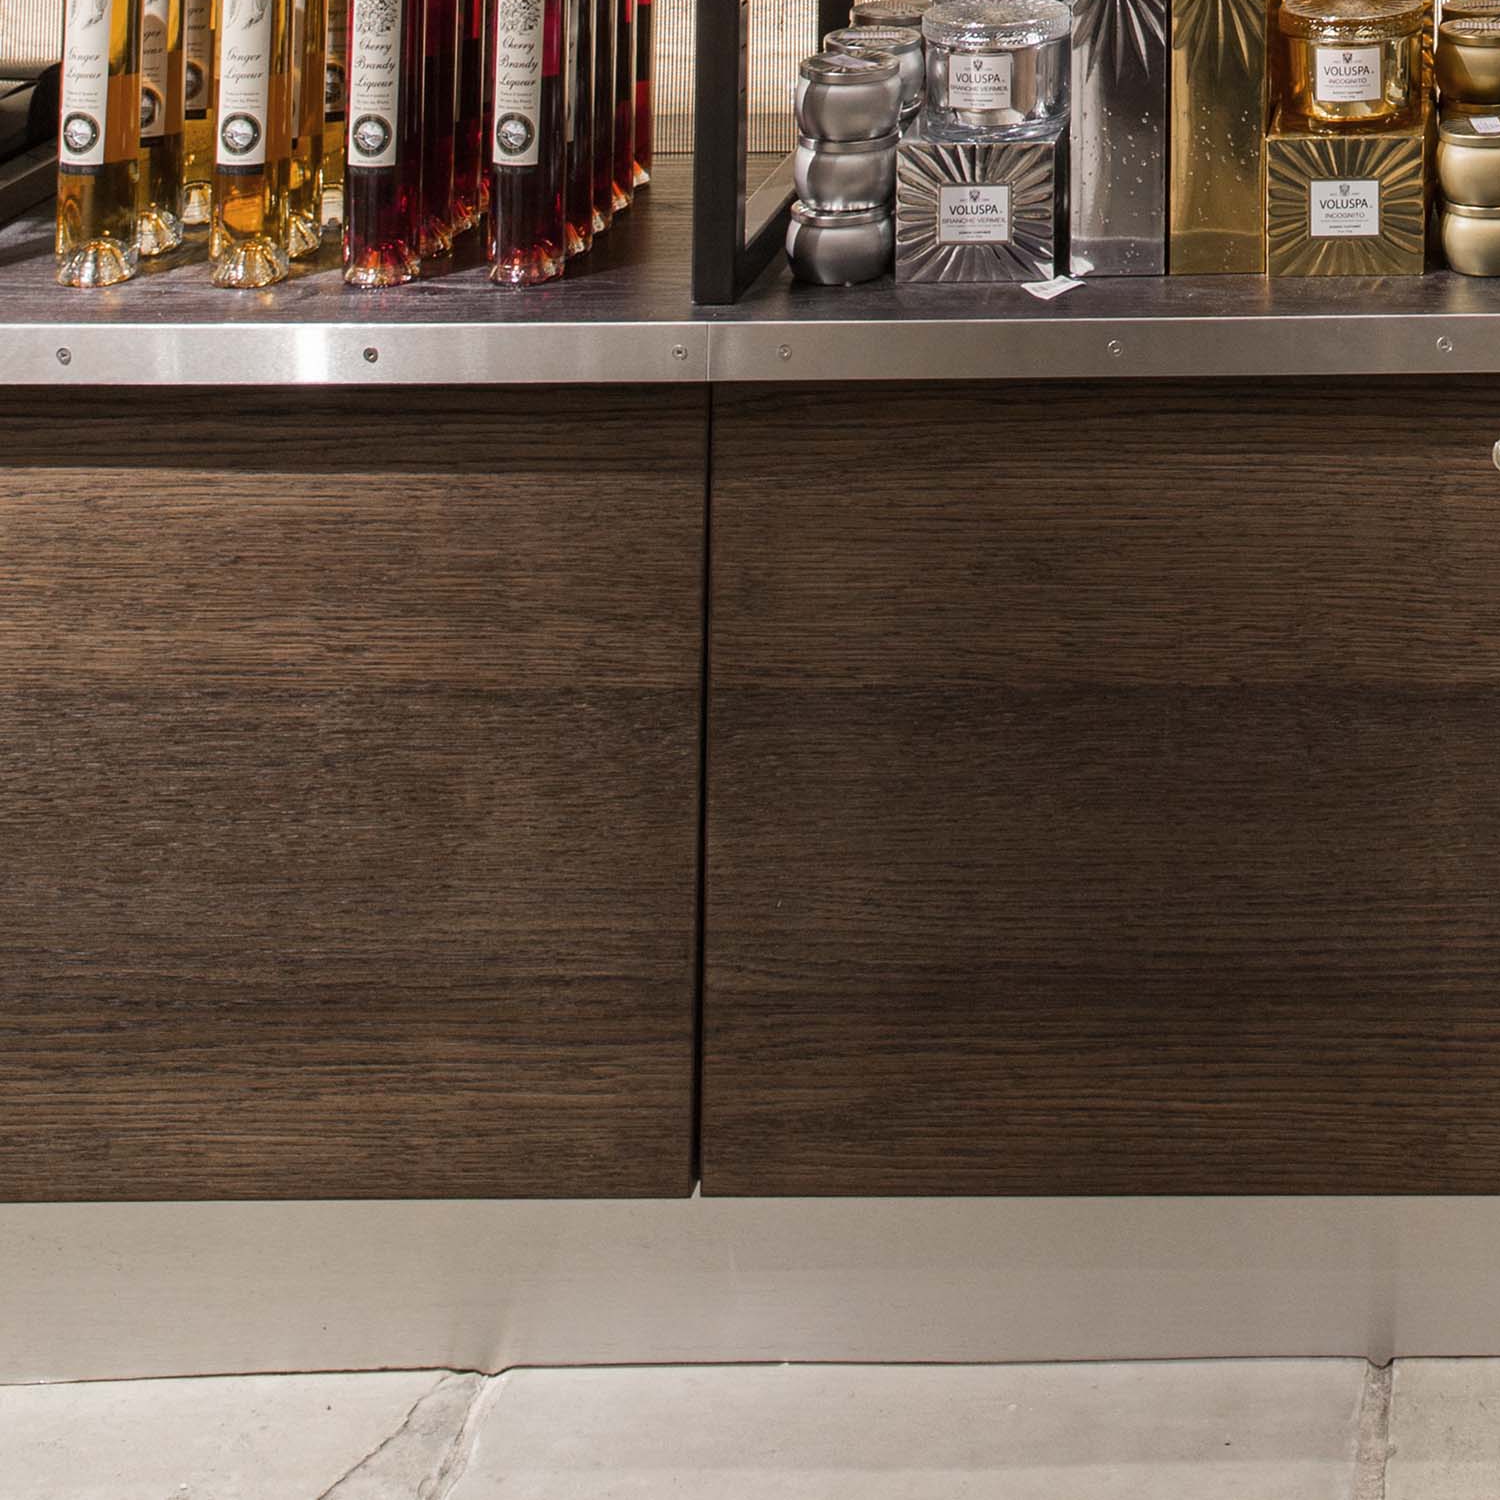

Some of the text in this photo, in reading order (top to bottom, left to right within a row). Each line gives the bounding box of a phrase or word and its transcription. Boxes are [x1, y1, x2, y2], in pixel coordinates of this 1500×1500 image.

[359, 39, 393, 56] Cherry
[502, 36, 535, 55] Cherry
[226, 45, 262, 64] Ginger
[354, 55, 396, 75] Brandy
[499, 55, 539, 74] Brandy
[1323, 65, 1370, 77] VOLUSPA
[224, 66, 264, 85] Liqueur
[354, 74, 393, 93] Liqueur
[499, 73, 536, 90] Liqueur
[955, 72, 1000, 84] VOLUSPA
[1328, 77, 1368, 85] INCOGNITO
[949, 204, 999, 216] VOLUSPA
[1319, 198, 1369, 210] VOLUSPA
[1324, 211, 1366, 219] INCOGNITO
